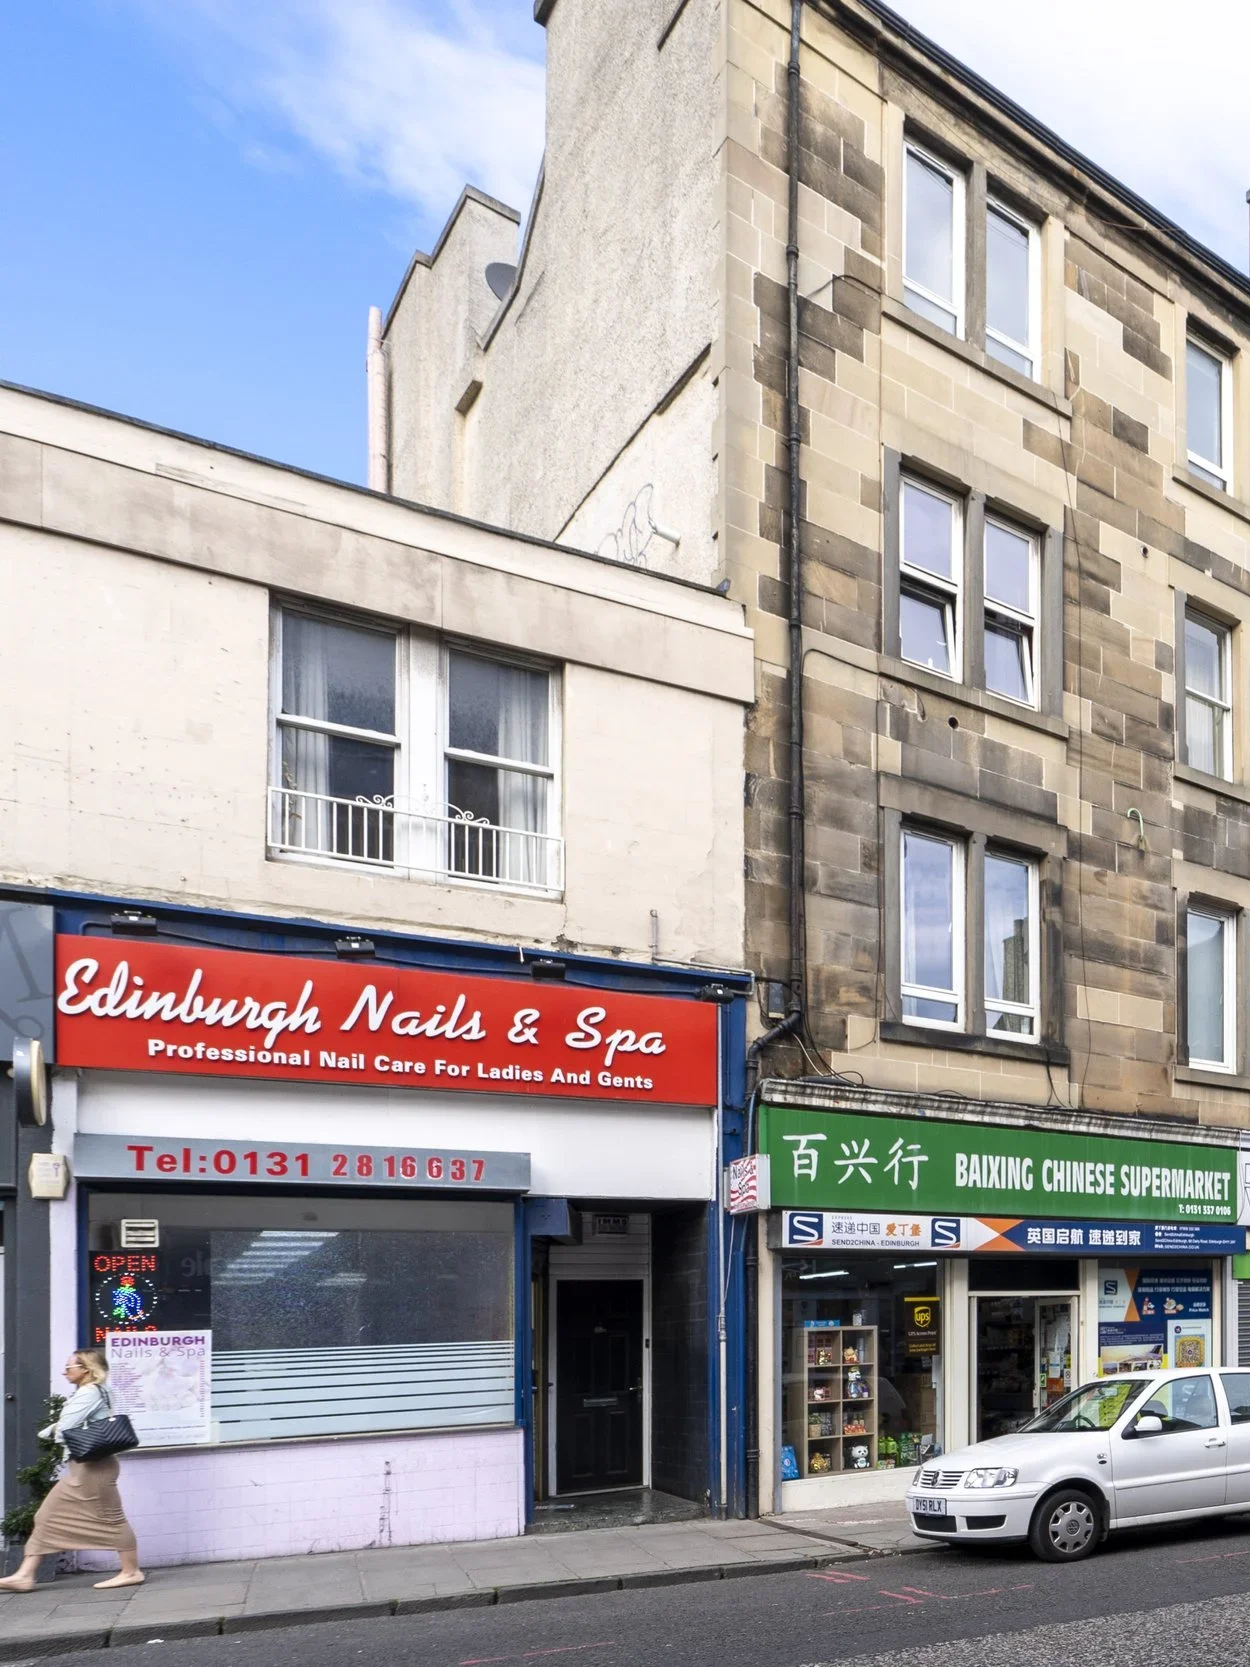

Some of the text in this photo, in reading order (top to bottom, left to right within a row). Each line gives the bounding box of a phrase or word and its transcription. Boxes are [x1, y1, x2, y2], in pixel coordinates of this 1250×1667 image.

[57, 957, 667, 1068] Edinburgh Nails & Spa
[147, 1038, 654, 1090] Professional Nail Care For Ladies And Gents
[782, 1133, 929, 1190] 百兴行
[955, 1152, 1231, 1201] BAIXING CHINESE SUPERMARKET
[1185, 1204, 1202, 1215] 0131
[1202, 1205, 1215, 1215] 337
[831, 1221, 922, 1237] 速递中国 爱丁堡
[1027, 1227, 1141, 1246] 英国启航 速递到家
[94, 1255, 157, 1272] OPEN
[915, 1312, 930, 1325] ups
[111, 1336, 206, 1347] EDINBURGH
[111, 1346, 206, 1360] Nails & Spa
[928, 1500, 942, 1512] RLX
